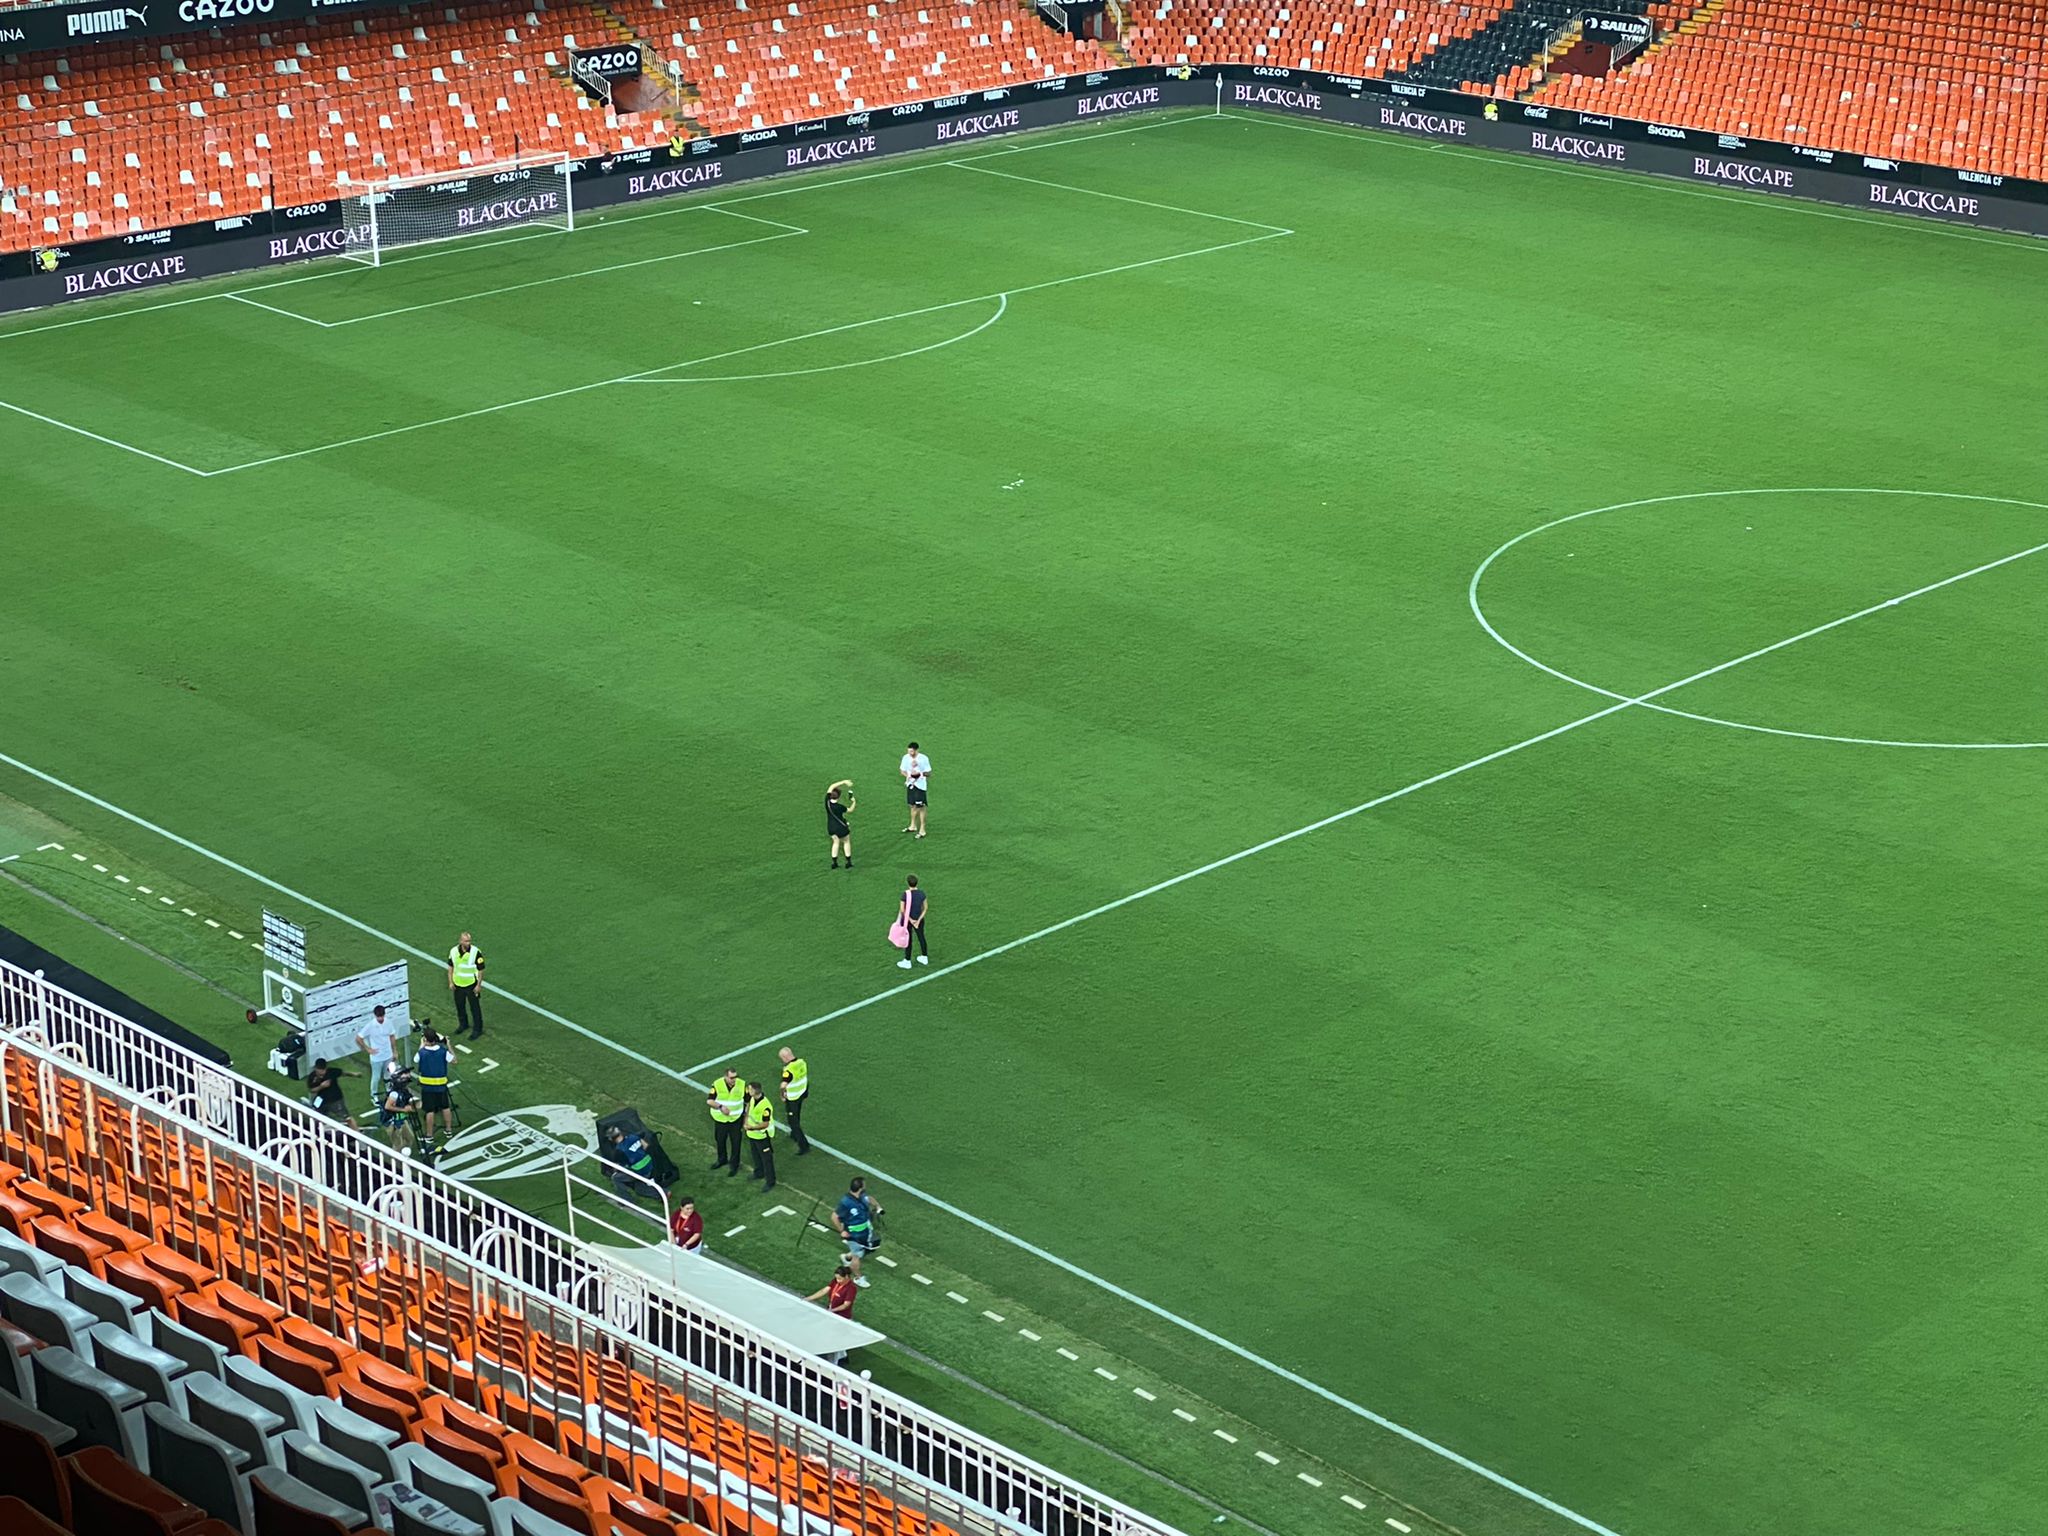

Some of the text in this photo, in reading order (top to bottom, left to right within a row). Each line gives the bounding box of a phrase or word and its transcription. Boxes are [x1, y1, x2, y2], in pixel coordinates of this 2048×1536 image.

[67, 8, 126, 36] PUMA
[178, 0, 274, 22] CAZOO
[1600, 20, 1647, 34] SAILUN
[577, 50, 638, 72] CAZOO
[1253, 67, 1290, 77] CAZOO
[1078, 87, 1160, 115] BLACKCAPE
[1235, 85, 1322, 110] BLACKCAPE
[1391, 84, 1426, 97] VALENCIA CF
[892, 103, 923, 116] CAZOO
[934, 95, 968, 109] VALENCIA CF
[937, 110, 1020, 140] BLACKCAPE
[1380, 107, 1467, 136] BLACKCAPE
[1647, 124, 1686, 139] ŠKODA
[741, 129, 778, 144] ŠKODA
[1531, 131, 1626, 161] BLACKCAPE
[622, 150, 651, 161] SAILUN
[786, 135, 876, 166] BLACKCAPE
[1801, 147, 1834, 158] SAILUN
[628, 162, 723, 195] BLACKCAPE
[1694, 157, 1794, 188] BLACKCAPE
[1957, 170, 2003, 186] VALENCIA CF
[286, 203, 327, 218] CAZOO
[457, 192, 559, 227] BLACKCAPE
[1869, 184, 1979, 217] BLACKCAPE
[135, 230, 171, 243] SAILUN
[64, 256, 186, 295] BLACKCAPE
[500, 1117, 554, 1147] VALENCIA
